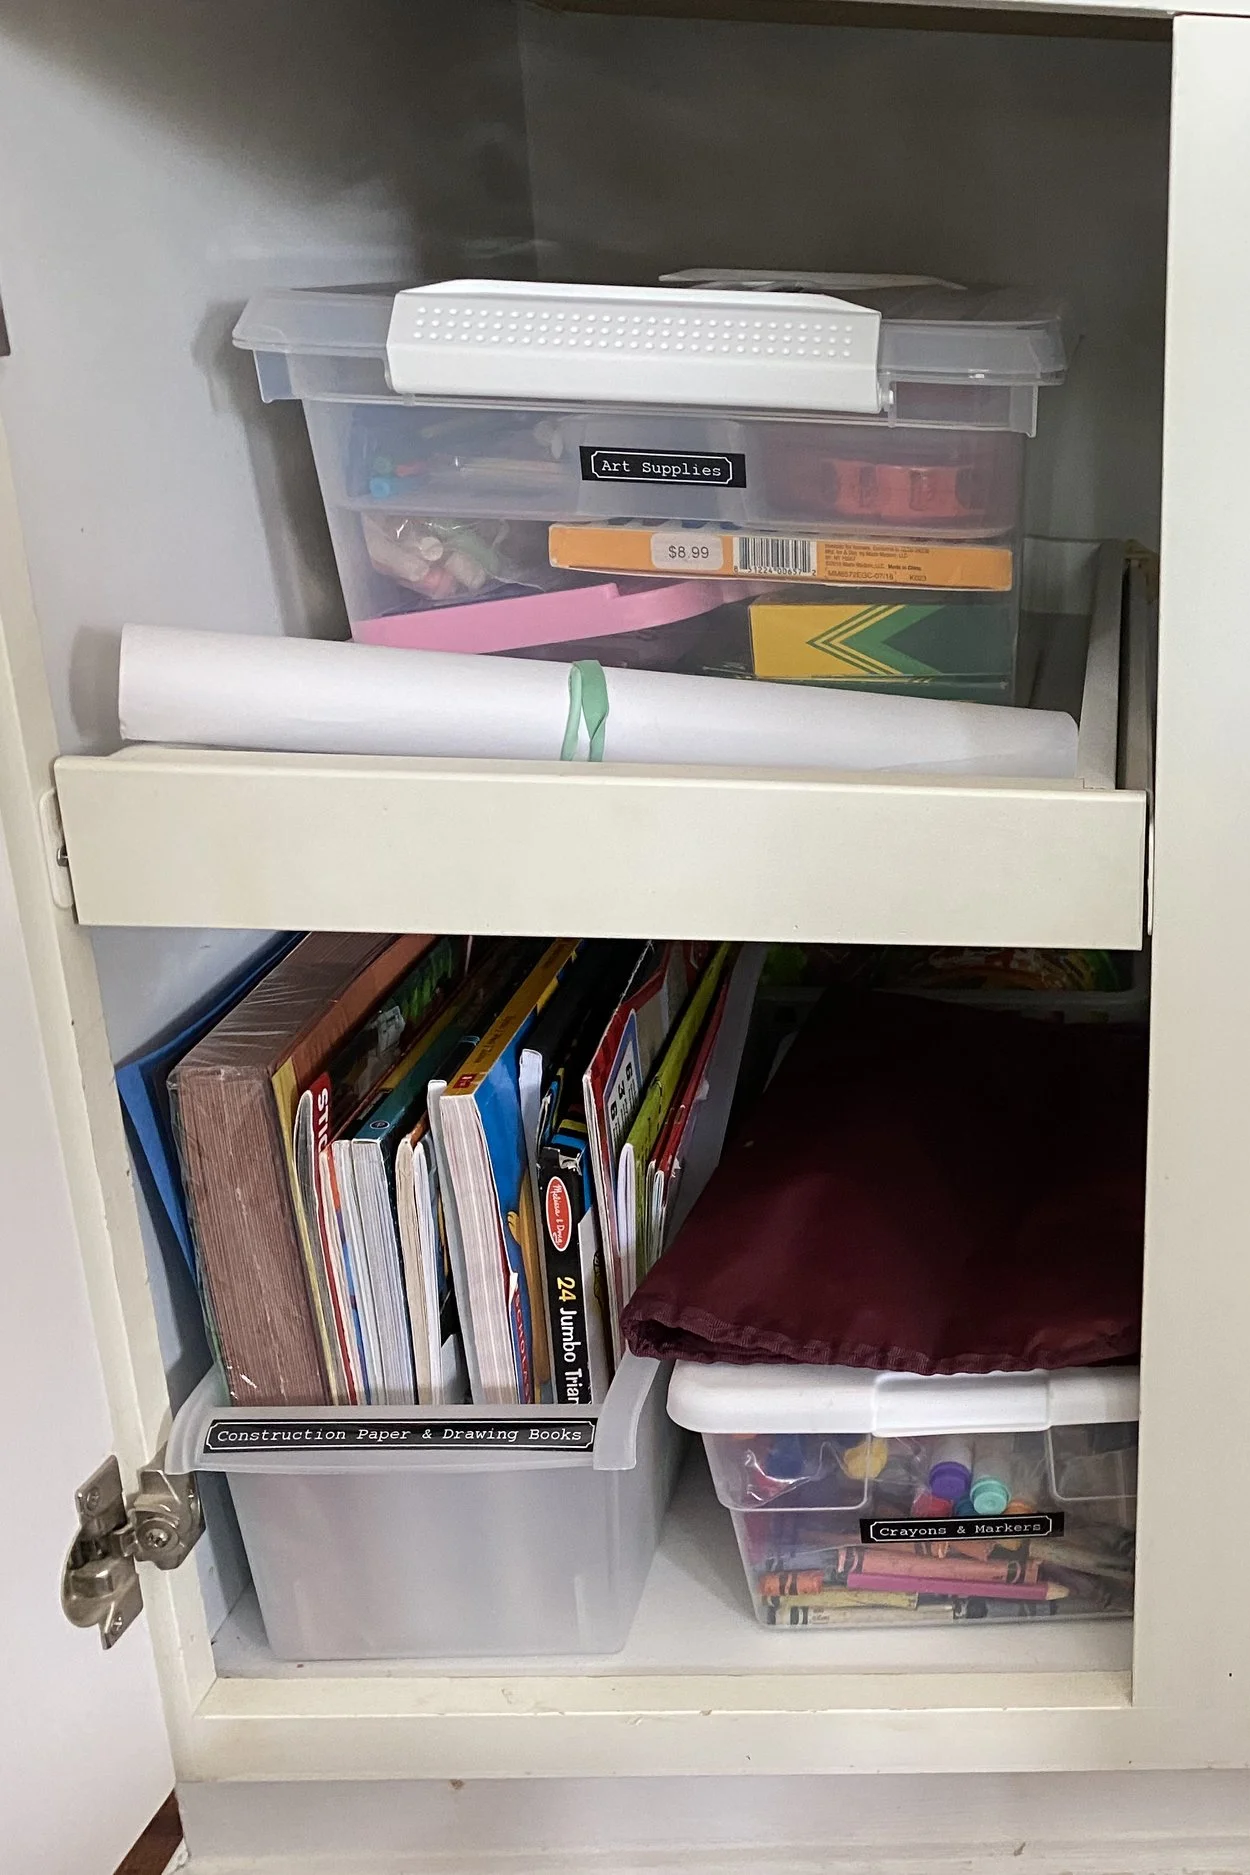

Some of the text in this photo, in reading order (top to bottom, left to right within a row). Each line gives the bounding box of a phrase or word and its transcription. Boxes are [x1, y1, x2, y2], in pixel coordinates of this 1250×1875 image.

[601, 459, 721, 478] Art Supplies
[668, 545, 710, 559] $8.99
[556, 1276, 577, 1303] 24
[559, 1307, 582, 1364] Jumbo
[513, 1293, 531, 1403] SCHOLAS
[217, 1428, 582, 1443] Construction Paper & Drawing Books
[879, 1521, 1041, 1538] Crayons & Markers
